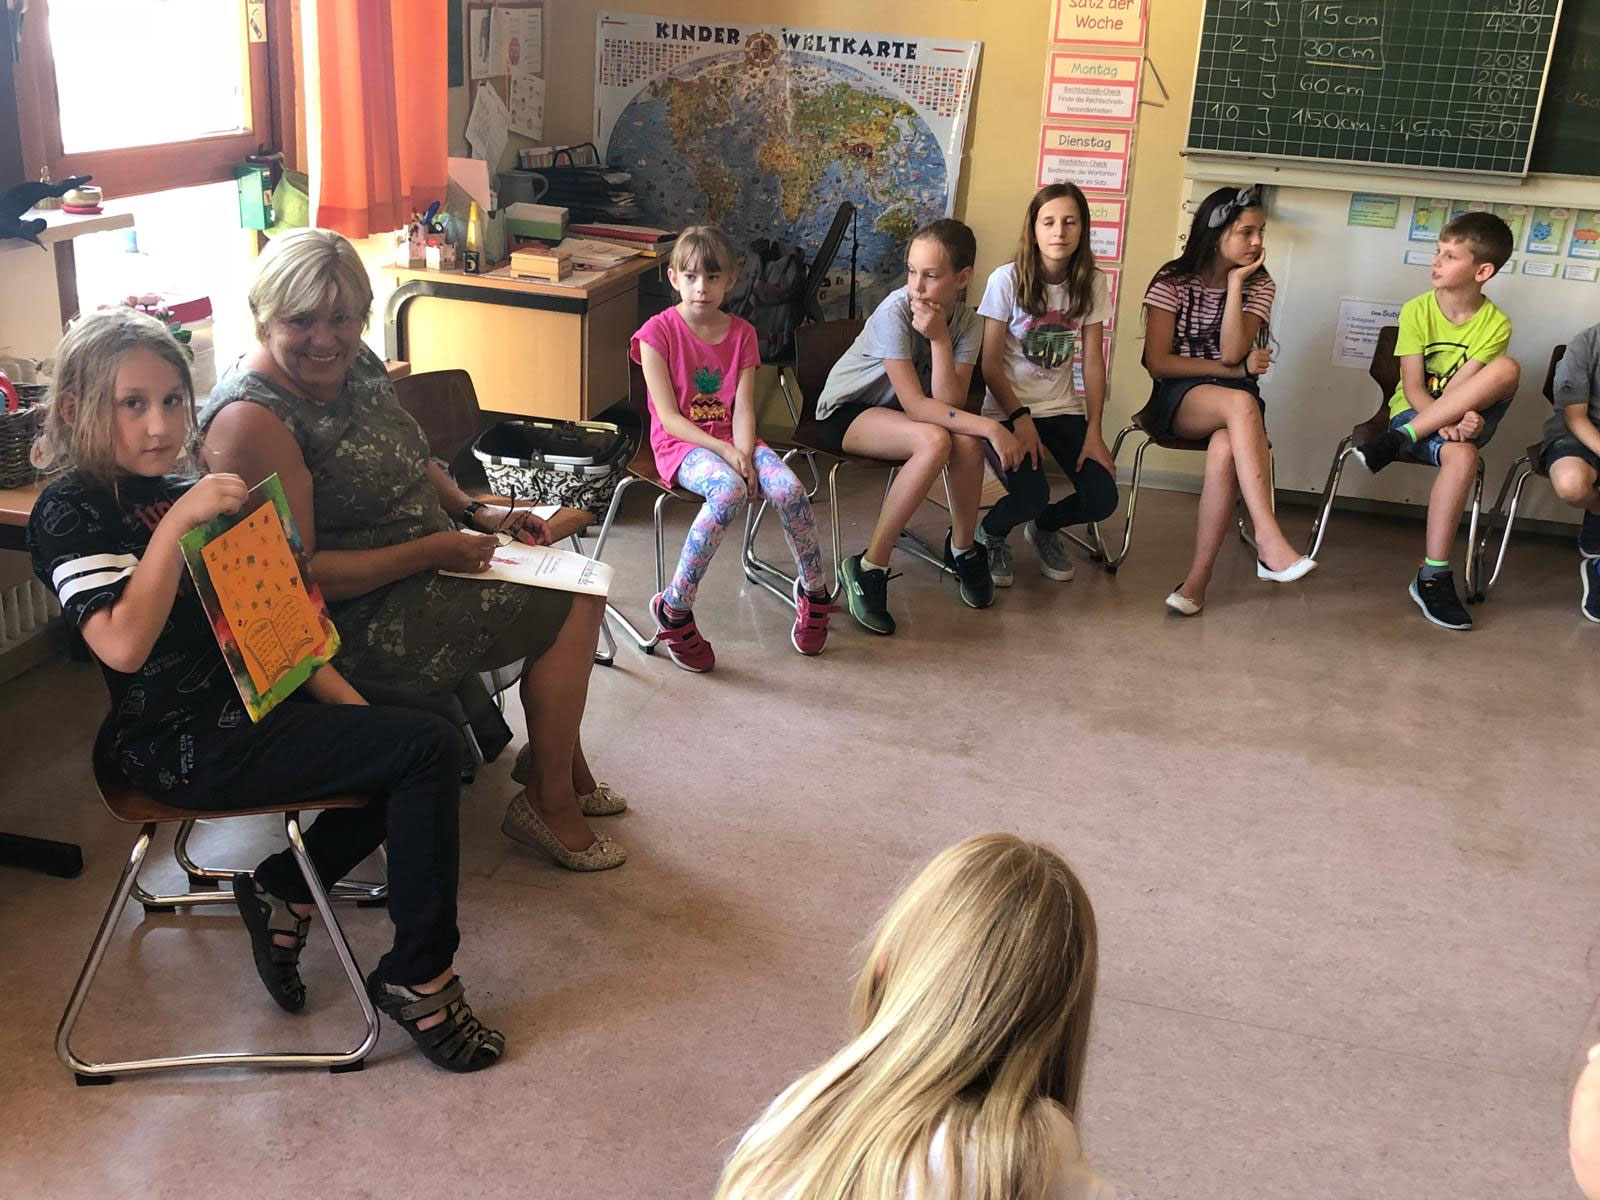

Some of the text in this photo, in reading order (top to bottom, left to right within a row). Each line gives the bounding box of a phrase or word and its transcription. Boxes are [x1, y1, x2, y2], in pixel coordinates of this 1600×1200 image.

[1076, 14, 1124, 30] Woche
[656, 22, 917, 60] KINDER WELTKARTE
[1232, 35, 1247, 52] 2
[1480, 52, 1530, 70] 208
[1071, 63, 1118, 79] Montag
[1229, 71, 1241, 88] 4
[1211, 103, 1240, 121] 10
[1466, 120, 1517, 139] 520
[1058, 134, 1111, 150] Dienstag
